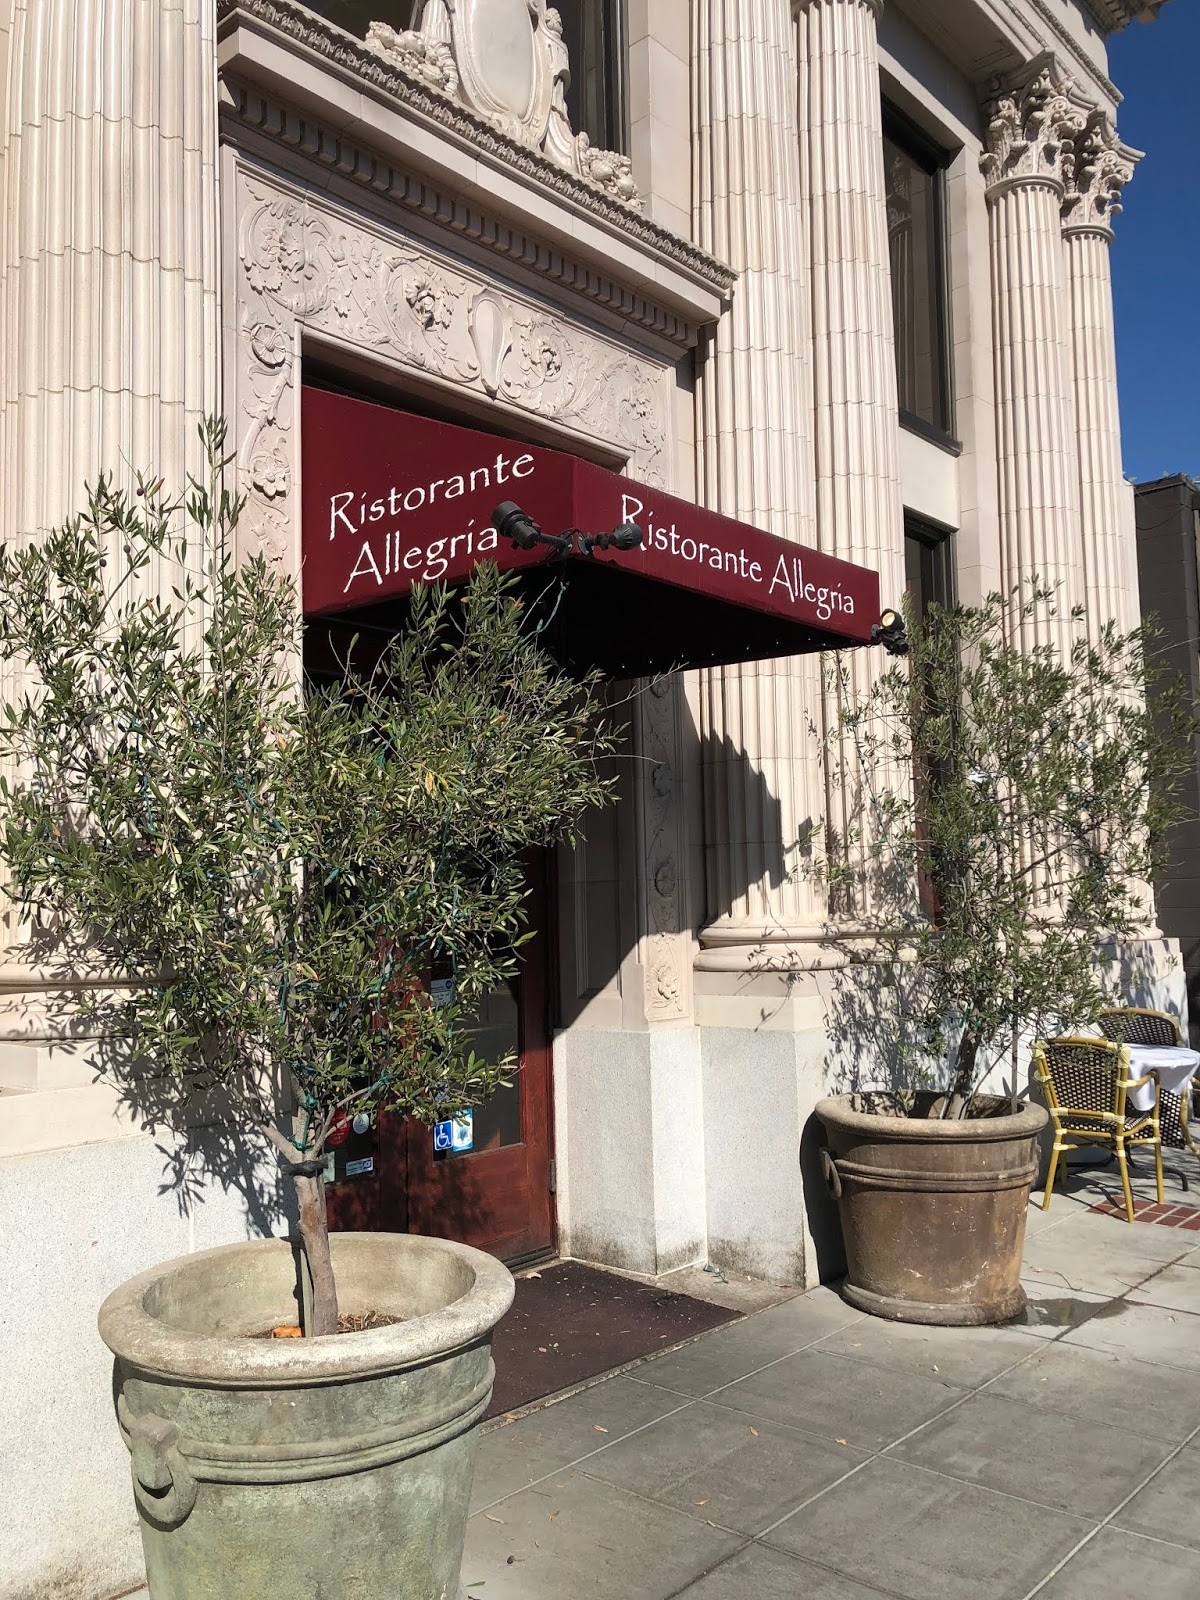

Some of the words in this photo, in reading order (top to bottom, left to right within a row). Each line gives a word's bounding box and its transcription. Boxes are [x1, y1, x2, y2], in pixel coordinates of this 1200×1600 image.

[329, 453, 535, 541] Ristorante
[343, 519, 498, 593] Allegria
[621, 493, 763, 583] Ristorante
[768, 553, 855, 621] Allegria
